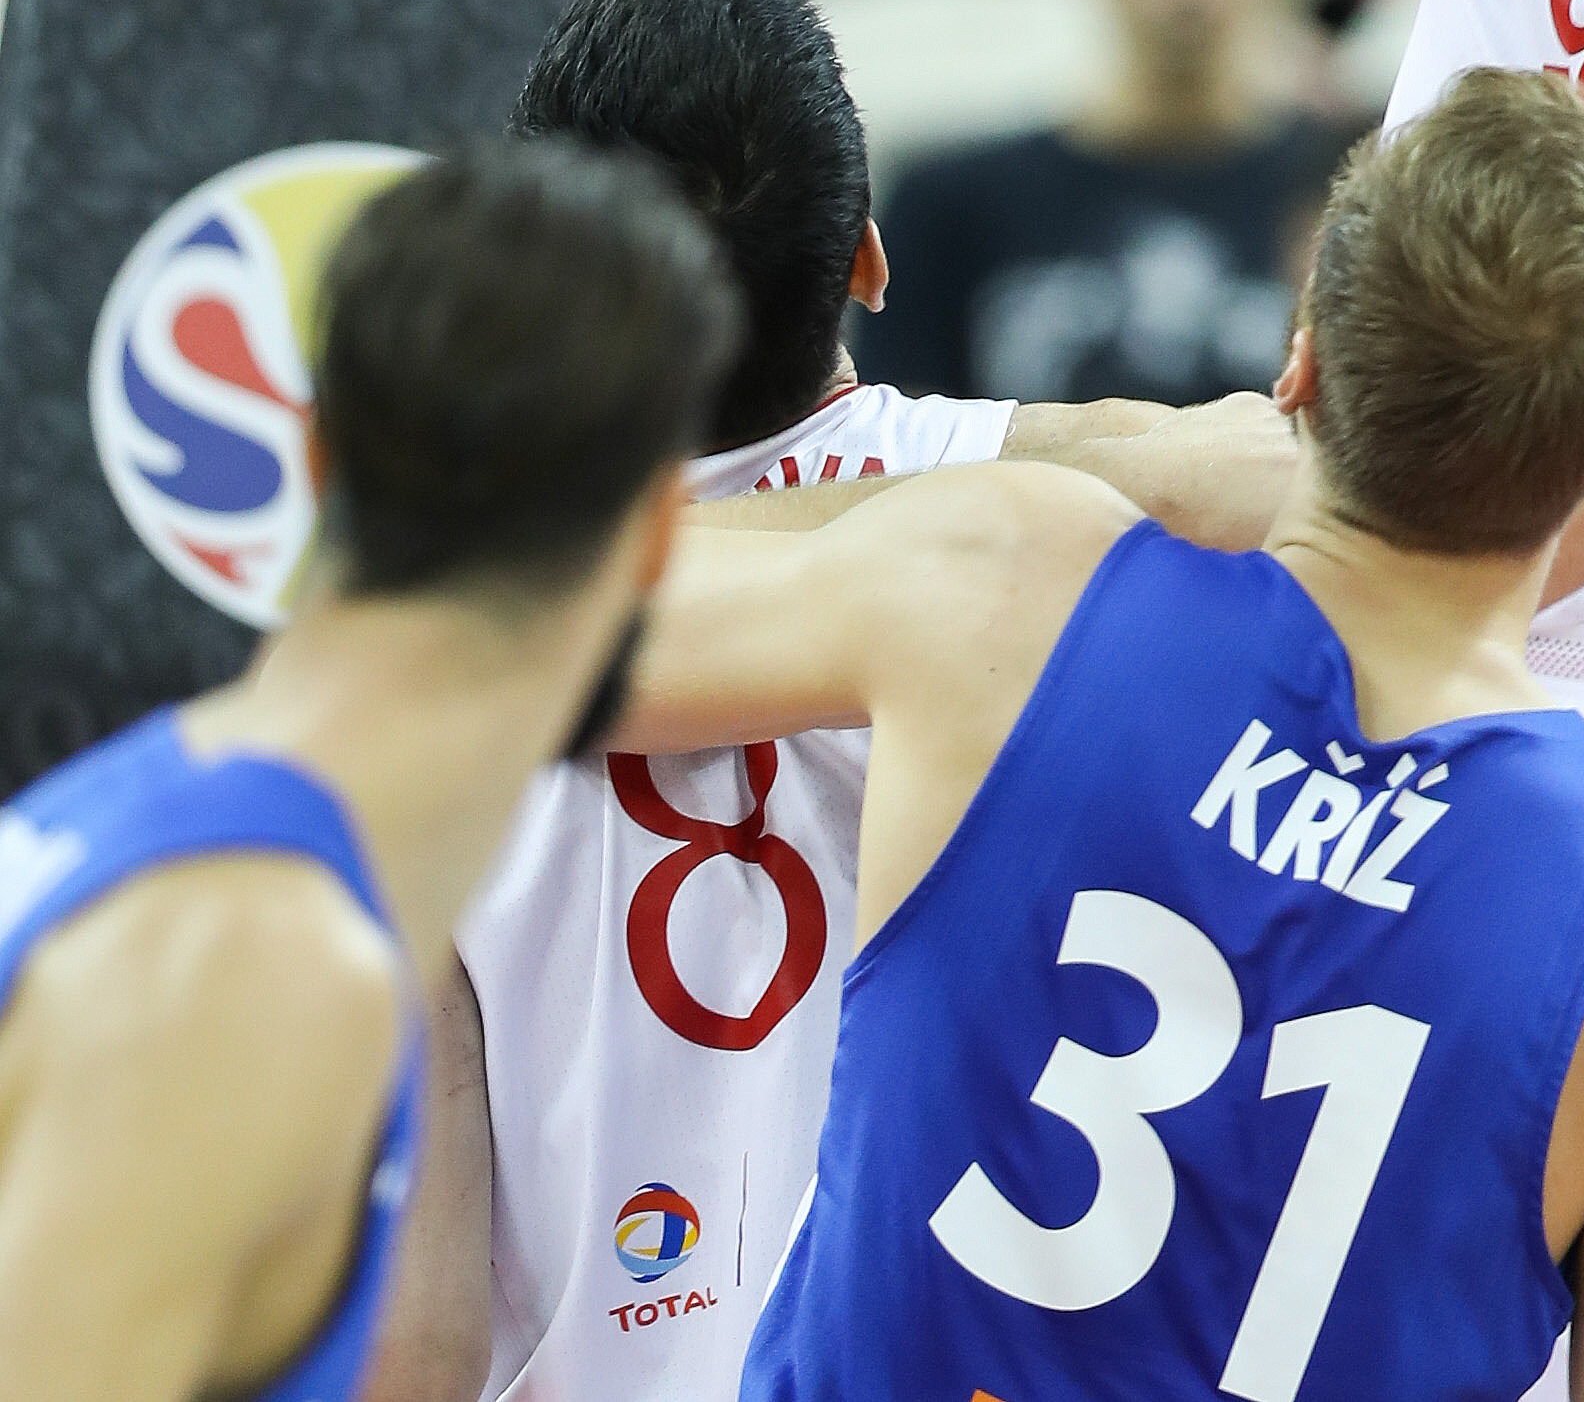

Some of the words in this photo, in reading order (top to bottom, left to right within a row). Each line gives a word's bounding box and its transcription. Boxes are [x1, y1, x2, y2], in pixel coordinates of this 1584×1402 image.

[1190, 718, 1451, 914] KŘÍŽ
[927, 888, 1432, 1402] 31
[609, 1286, 719, 1334] TOTAL
